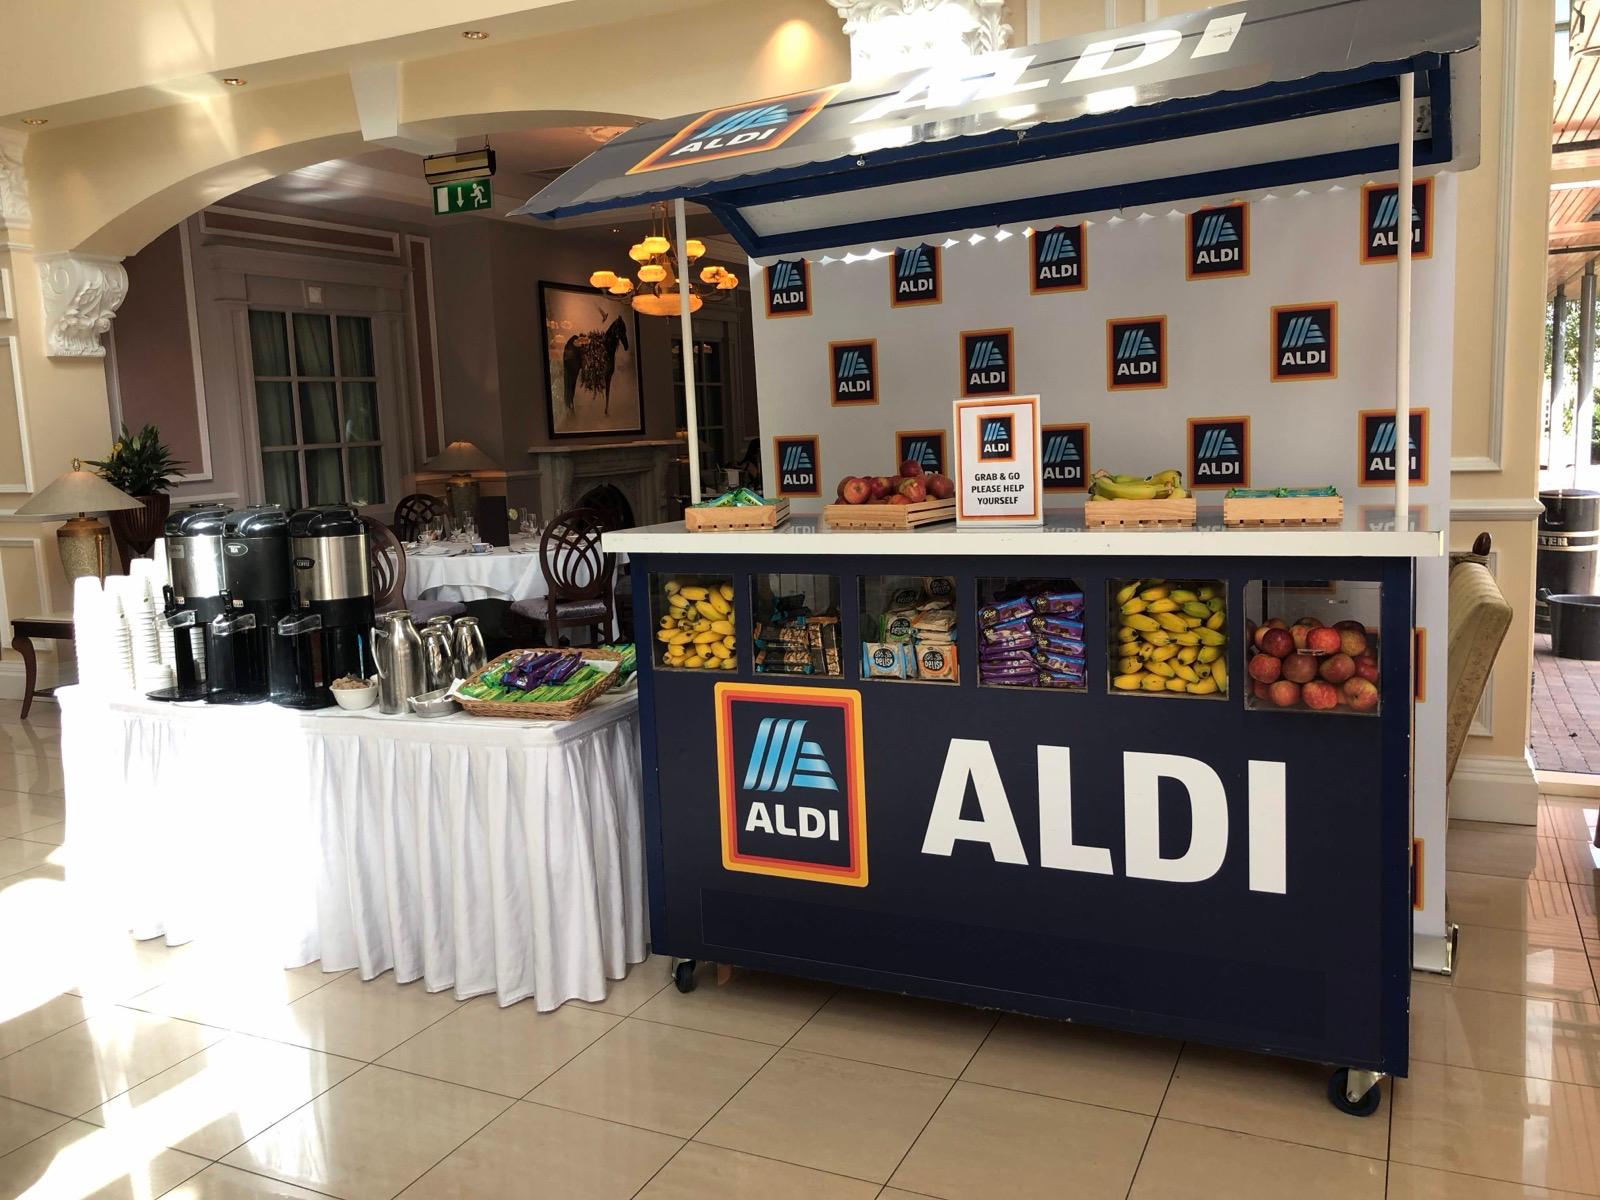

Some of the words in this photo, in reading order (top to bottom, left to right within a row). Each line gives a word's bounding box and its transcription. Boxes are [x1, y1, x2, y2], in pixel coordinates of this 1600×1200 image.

[669, 127, 778, 157] ALDI
[1372, 228, 1421, 247] ALI
[1197, 247, 1239, 265] ALDI
[1039, 263, 1078, 280] ALDI
[899, 278, 933, 294] ALDI
[772, 291, 804, 306] ALDI
[1281, 350, 1326, 366] ALDI
[1117, 360, 1157, 377] ALDI
[838, 378, 871, 393] ALDI
[969, 370, 1006, 386] ALDI
[983, 443, 1009, 453] ALDI
[1198, 461, 1240, 476] ALDI
[1369, 456, 1417, 471] ALI
[783, 473, 814, 486] ALDI
[974, 473, 998, 481] GRAB
[999, 472, 1006, 481] &
[1008, 472, 1021, 480] GO
[1043, 466, 1081, 480] ALDI
[971, 485, 1002, 493] PLEASE
[1003, 484, 1025, 492] HELP
[977, 496, 1019, 505] YOURSELF
[745, 801, 840, 842] ALDI
[921, 737, 1287, 895] ALDI
